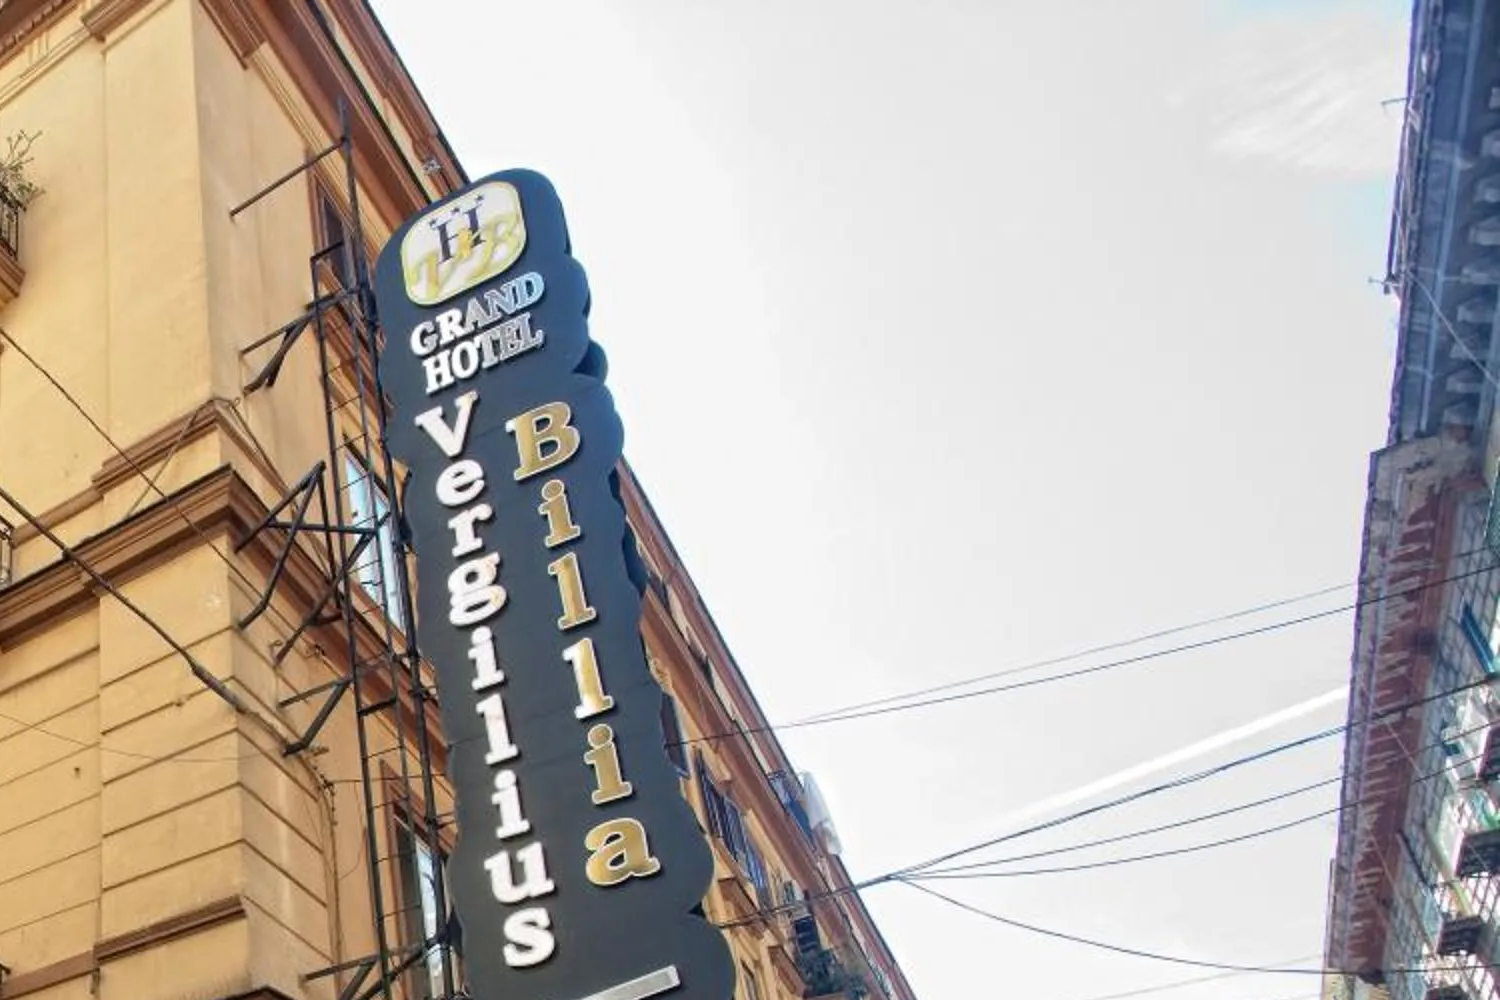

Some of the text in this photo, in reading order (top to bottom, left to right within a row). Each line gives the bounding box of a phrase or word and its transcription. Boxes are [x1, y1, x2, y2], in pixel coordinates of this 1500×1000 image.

[410, 271, 545, 357] GRAND
[422, 312, 545, 394] HOTEL
[414, 391, 556, 968] Vergilius
[505, 401, 661, 887] Billia
